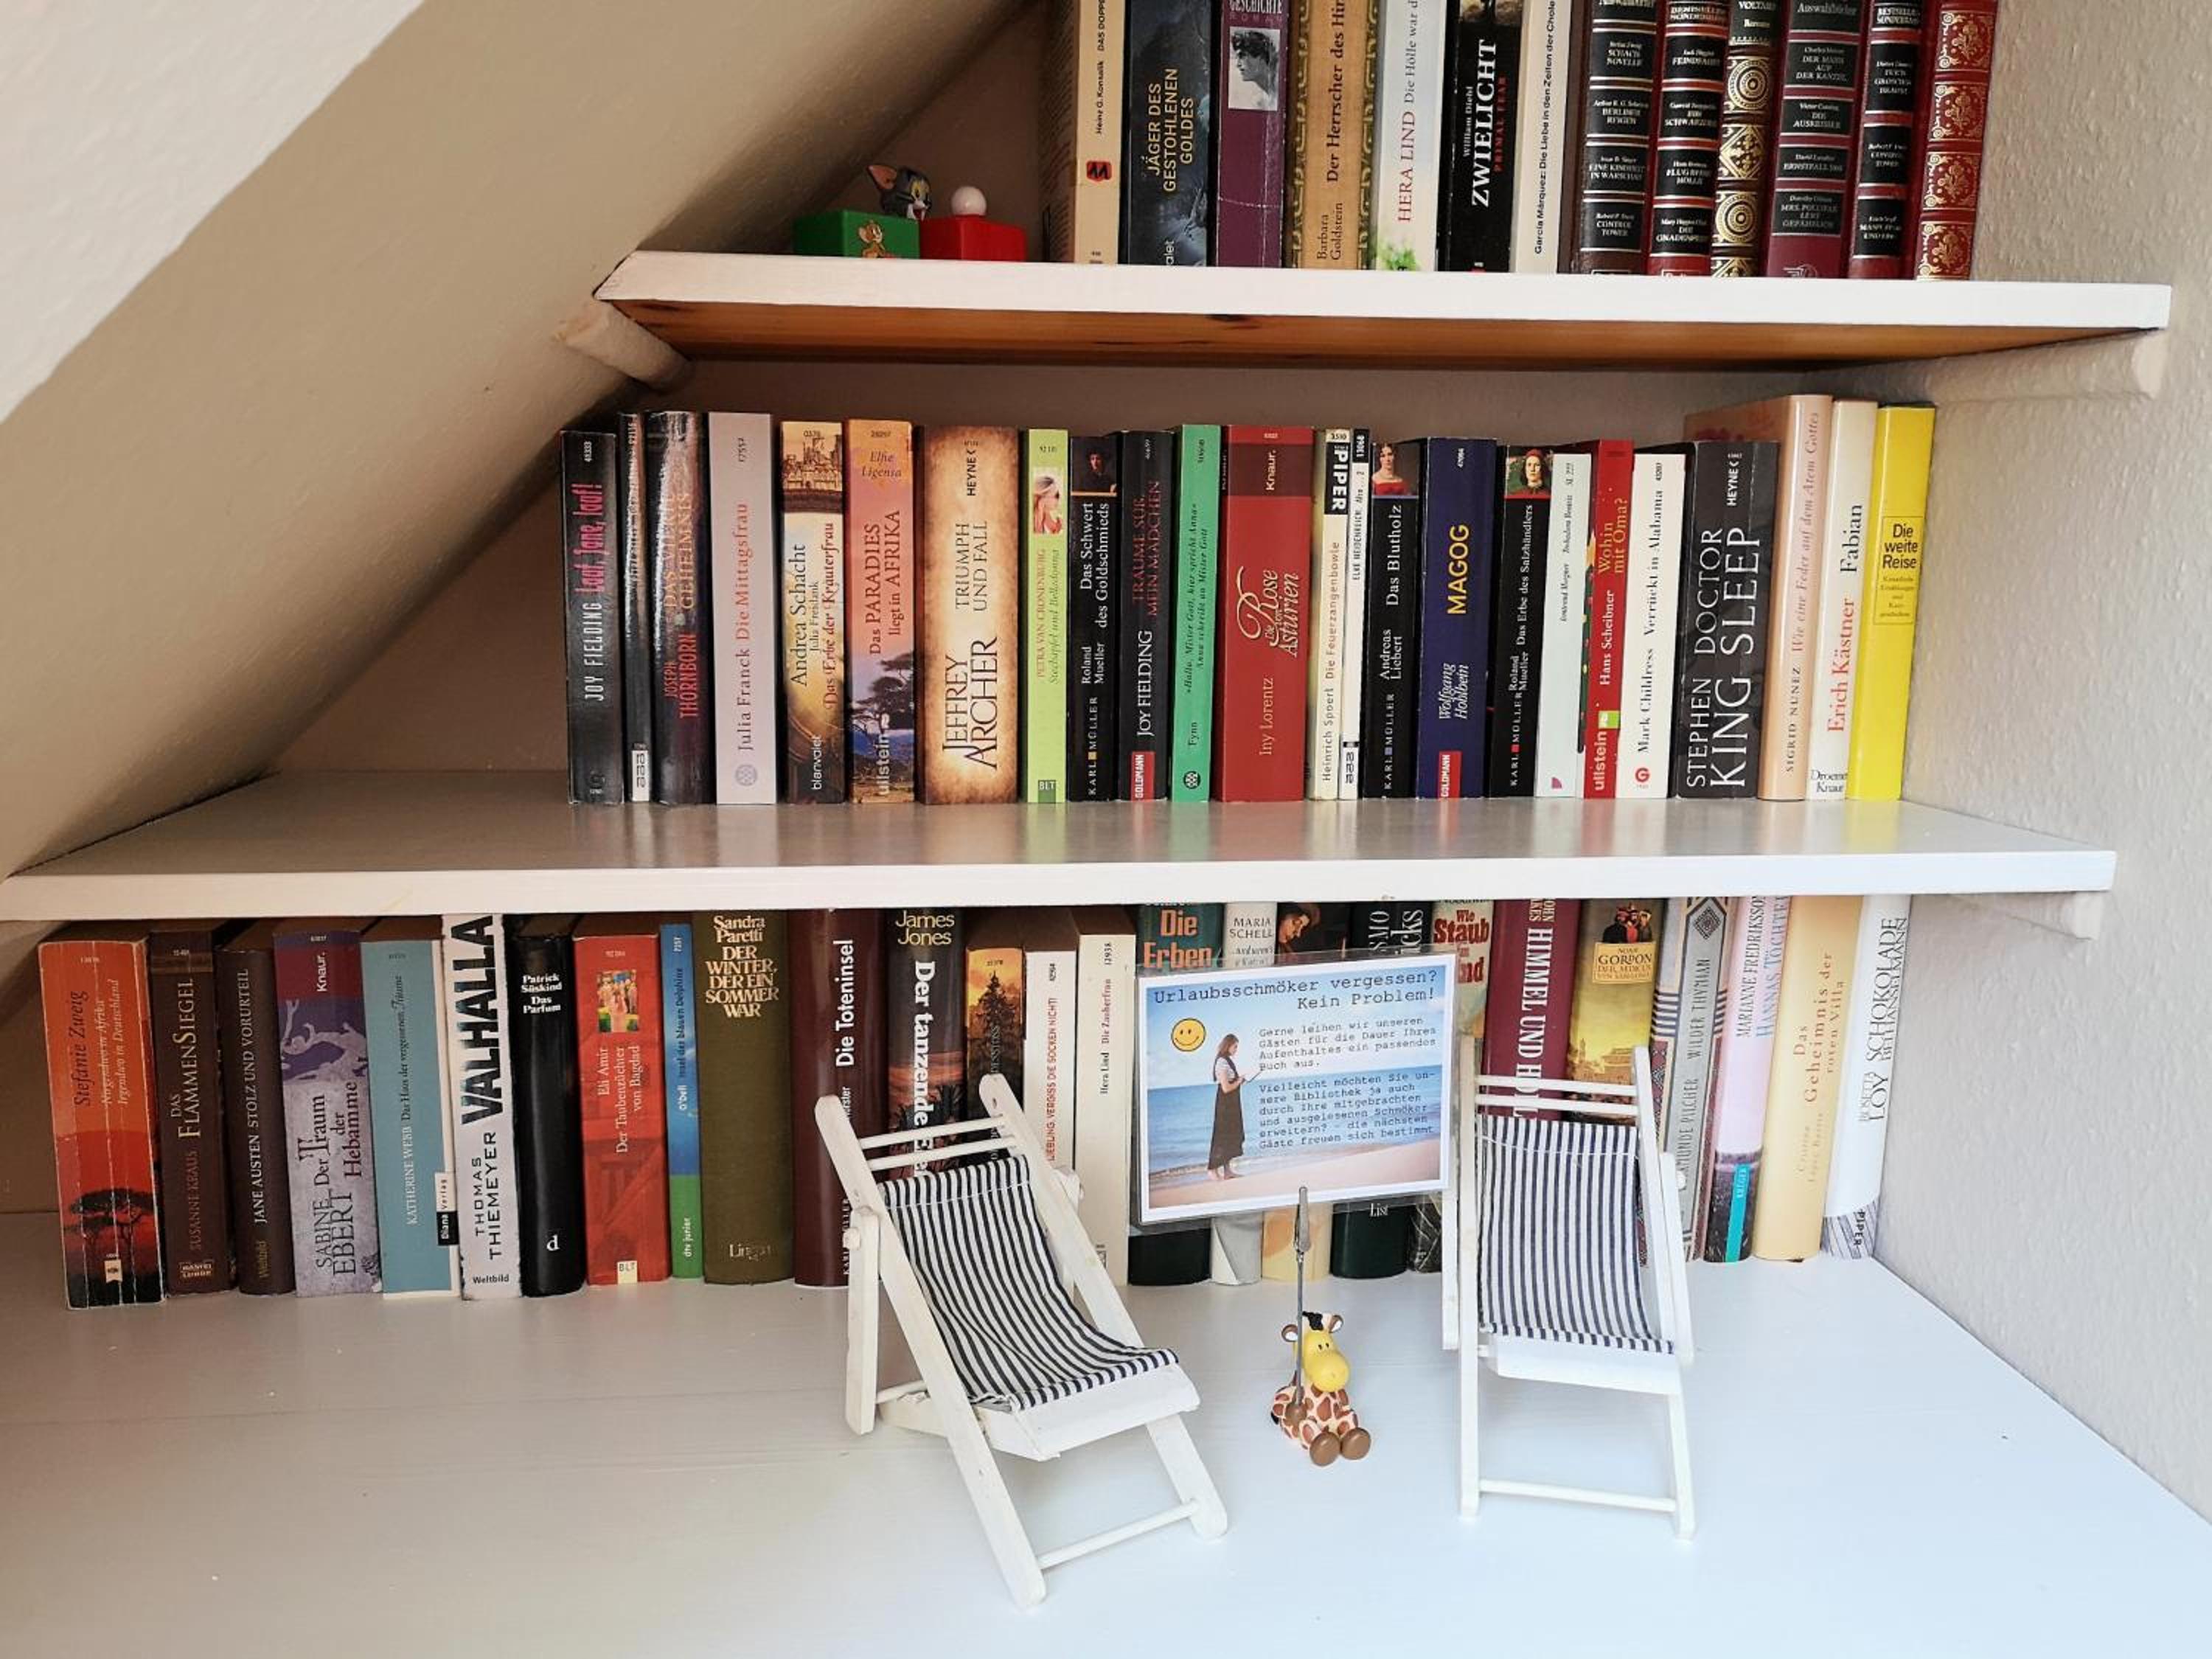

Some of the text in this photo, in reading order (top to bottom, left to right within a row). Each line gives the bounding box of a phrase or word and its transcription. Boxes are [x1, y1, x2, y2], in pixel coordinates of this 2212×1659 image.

[1404, 81, 1415, 104] Die
[1405, 41, 1416, 76] Hölle
[1144, 83, 1161, 175] JÄGER DES
[1164, 69, 1178, 191] GESTOHLENEN
[1181, 97, 1193, 164] GOLDES
[1327, 32, 1343, 182] Der Herrscher des
[1472, 39, 1496, 207] ZWIELICHT
[1397, 111, 1415, 221] HERA LIND
[1318, 215, 1328, 260] Barbara
[1331, 203, 1343, 260] Goldstein
[1265, 450, 1276, 491] Knaur.
[1330, 450, 1348, 509] PIPER
[1726, 468, 1738, 506] HEYNE
[571, 484, 608, 594] Lauf, Jane, lauf!
[955, 524, 970, 609] TRIUMPH
[973, 521, 987, 612] UND FALL
[1080, 503, 1093, 590] Das Schwert
[1094, 503, 1110, 627] des Goldschmieds
[1386, 505, 1402, 606] Das Blutholz
[1447, 525, 1469, 614] MAGOG
[1598, 522, 1614, 575] Wohin
[1613, 498, 1627, 574] mit Oma?
[1882, 555, 1916, 569] Reise
[1885, 542, 1918, 554] weite
[1892, 524, 1914, 538] Die
[864, 524, 881, 655] Das PARADIES
[885, 510, 904, 636] liegt in AFRIKA
[1516, 505, 1534, 645] Das Erbe des Salzhändlers
[1694, 529, 1722, 653] DOCTOR
[1720, 527, 1760, 655] SLEEP
[582, 602, 605, 701] JOY FIELDING
[734, 504, 754, 751] Julia Franck Die Mittagsfrau
[789, 544, 808, 686] Andrea Schacht
[1280, 573, 1299, 658] Asturien
[1599, 591, 1615, 685] Hans Scheibner
[1638, 490, 1664, 753] Mark Childress Verrückt in Alabama
[1827, 504, 1862, 731] Erich Kästner Fabian
[1080, 647, 1091, 684] Roland
[1094, 642, 1105, 684] Mueller
[1137, 630, 1154, 737] JOY FIELDING
[1321, 543, 1340, 782] Heinrich Spoerl Die Feuerzangenbowle
[1380, 629, 1391, 680] Andreas
[1391, 636, 1403, 680] Liebert
[1439, 664, 1458, 720] Wolfgang
[1455, 664, 1469, 720] Hohlbein
[942, 655, 978, 751] JEFFREY
[964, 638, 998, 770] ARCHER
[1189, 722, 1199, 746] Fynn
[1259, 678, 1274, 756] Iny Lorentz
[1686, 678, 1711, 787] STEPHEN
[1711, 677, 1751, 787] KING
[876, 734, 890, 796] ullstein
[1134, 754, 1145, 799] GOLDMANN
[1441, 754, 1451, 797] GOLDMANN
[1593, 731, 1606, 790] ullstein
[713, 916, 765, 930] Sandra
[715, 928, 763, 943] Paretti
[722, 947, 757, 961] DER
[896, 910, 956, 927] James
[898, 932, 951, 945] Jones
[1160, 909, 1198, 937] Die
[1434, 918, 1489, 945] Staub
[1456, 910, 1475, 922] Wie
[705, 959, 777, 975] WINTER,
[709, 973, 773, 989] DER EIN
[1144, 944, 1212, 969] Erben
[1155, 971, 1438, 1004] Urlaubsschmöker vergessen?
[1517, 928, 1554, 1059] HIMMEL UND
[451, 916, 503, 1124] VALHALLA
[706, 987, 779, 1004] SOMMER
[723, 1004, 762, 1018] WAR
[833, 939, 855, 1067] Die Toteninsel
[1259, 1029, 1293, 1037] Gerne
[1302, 1024, 1342, 1032] leihen
[1376, 1018, 1424, 1027] unseren
[1298, 990, 1434, 1009] Kein Problem!
[1804, 953, 1832, 1103] Geheimnis der
[1826, 981, 1844, 1074] roten Villa
[68, 991, 91, 1106] Stefanie Zweig
[914, 961, 936, 1125] Der tanzende
[1259, 1037, 1300, 1048] Gästen
[1310, 1036, 1328, 1044] für
[1259, 1046, 1341, 1060] Aufenthaltes
[1375, 1039, 1436, 1050] passendes
[1677, 959, 1709, 1122] PILCHER WILDER THYMIAN
[1792, 1026, 1807, 1056] Das
[237, 970, 268, 1223] JANE AUSTEN STOLZ UND VORURTEIL
[331, 1113, 345, 1135] der
[344, 1082, 363, 1177] Hebamme
[298, 1095, 330, 1186] Der Traum
[313, 1199, 333, 1268] SABINE
[329, 1189, 356, 1274] EBERT
[471, 1158, 484, 1237] THOMAS
[484, 1132, 502, 1259] THIEMEYER
